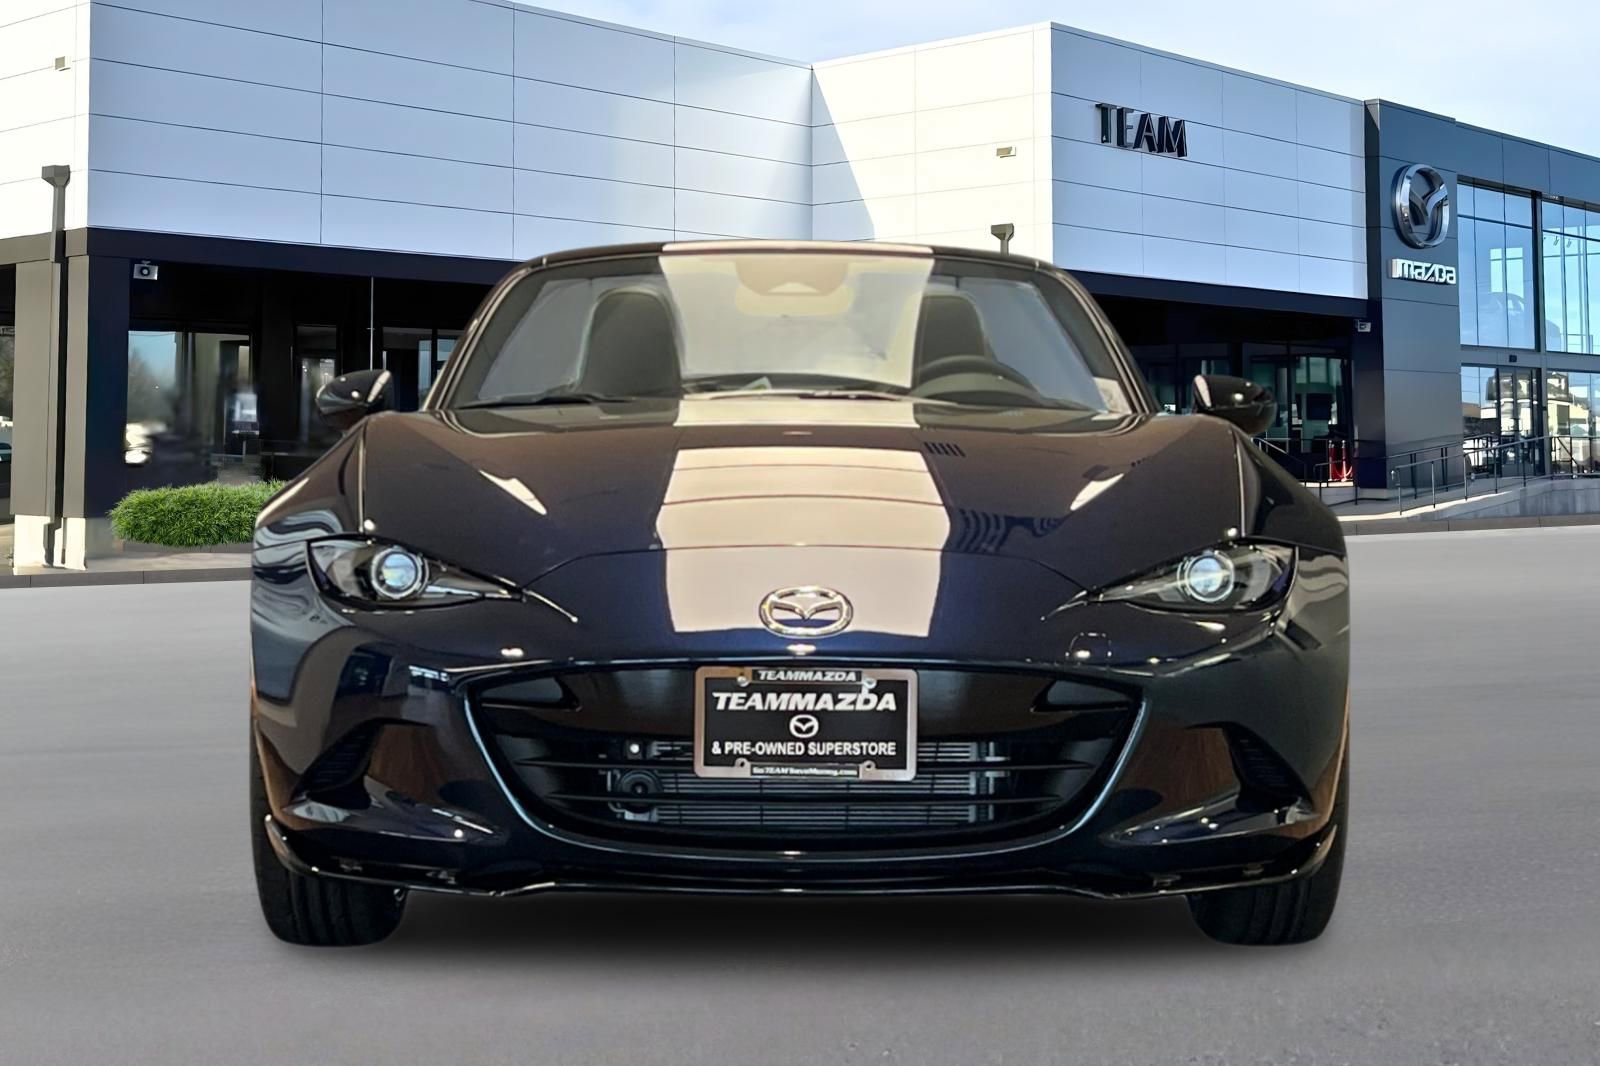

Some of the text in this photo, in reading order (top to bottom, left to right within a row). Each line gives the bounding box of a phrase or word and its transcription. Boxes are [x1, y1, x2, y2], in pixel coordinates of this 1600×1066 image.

[1095, 103, 1188, 157] TEAM
[758, 670, 857, 682] TEAMMAZDA
[712, 692, 897, 711] TEAMMAZDA
[711, 741, 897, 756] & PRE-OWNED SUPERSTORE
